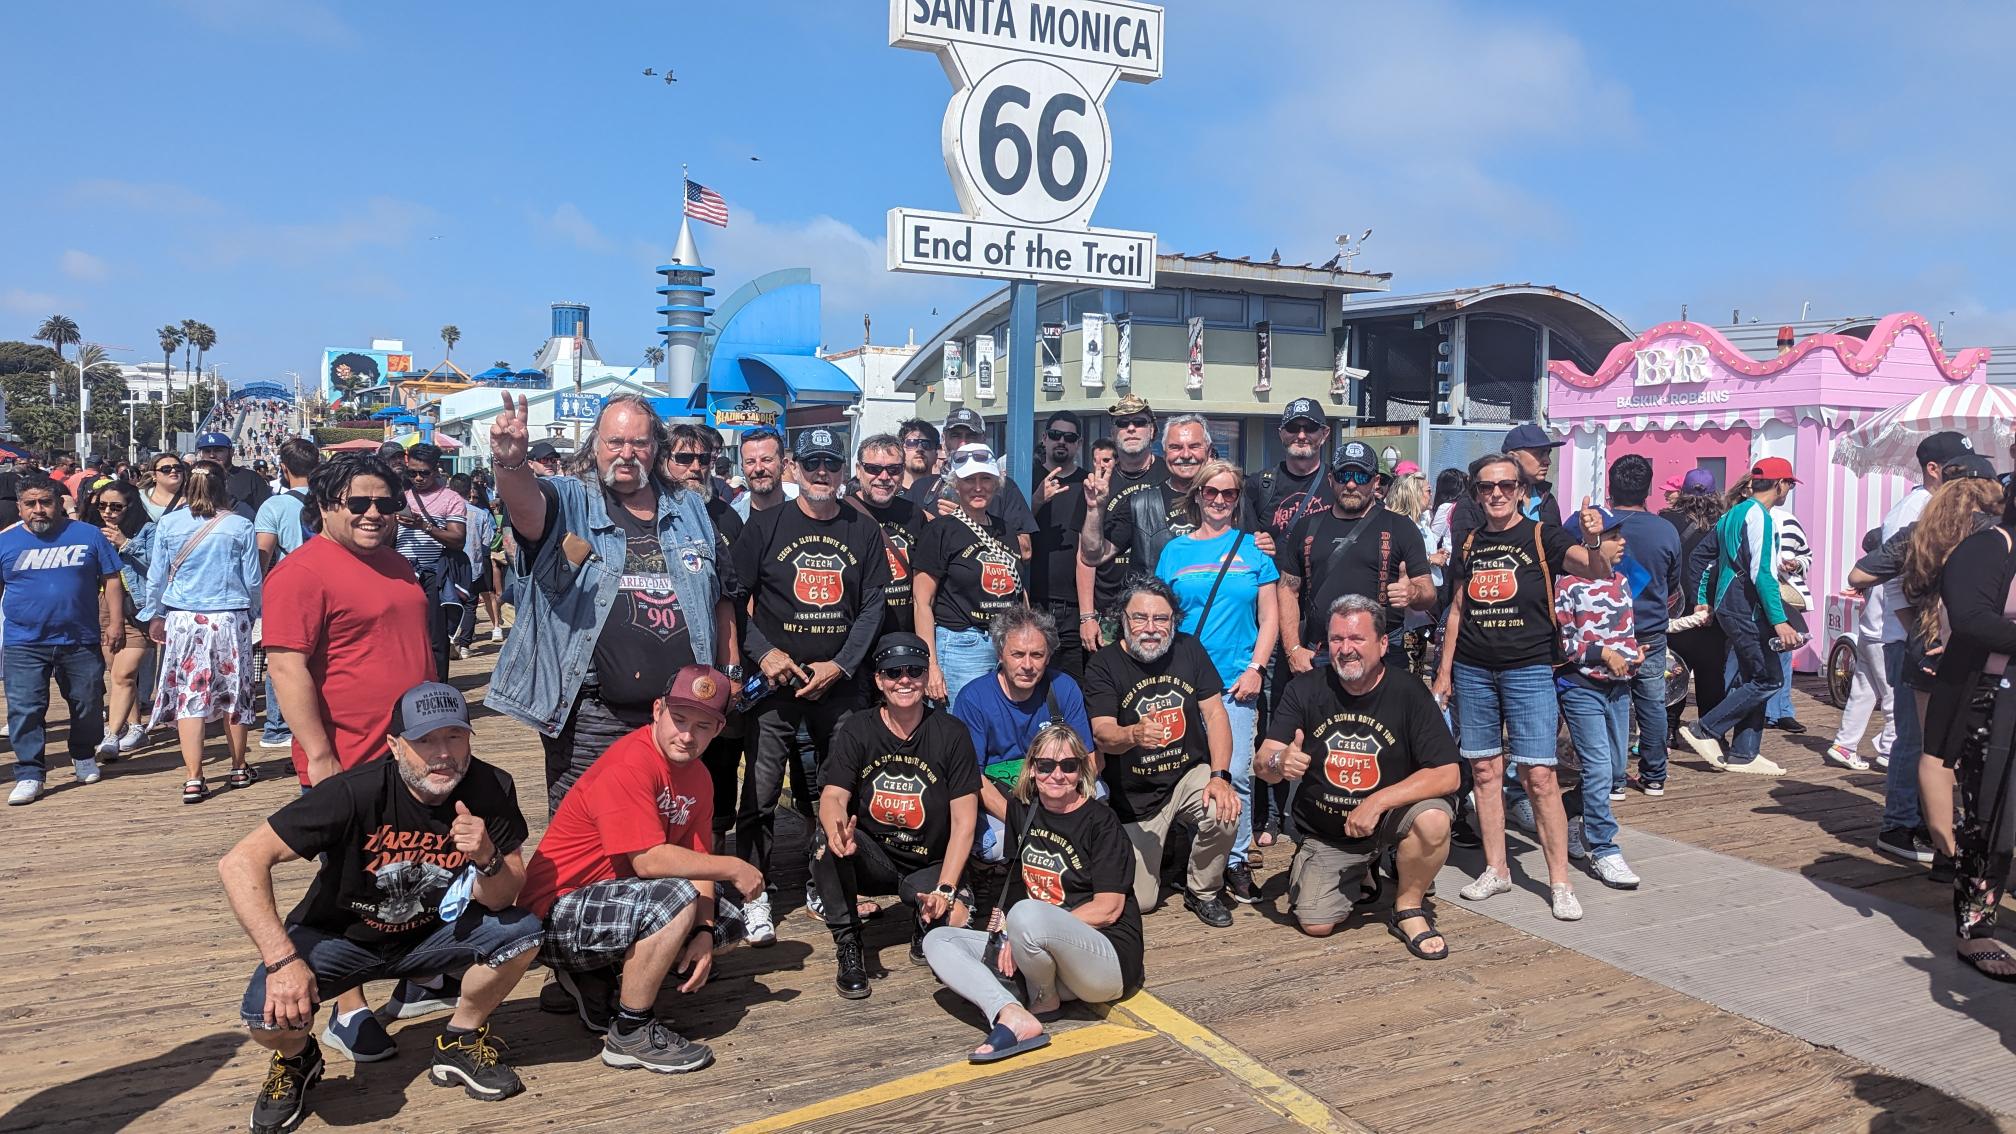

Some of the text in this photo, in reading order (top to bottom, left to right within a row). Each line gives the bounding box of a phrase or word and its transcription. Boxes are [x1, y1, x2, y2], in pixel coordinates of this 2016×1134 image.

[913, 0, 1152, 60] SANTA MONICA
[979, 85, 1088, 202] 66
[914, 225, 1143, 277] End of the Trail
[1634, 345, 1712, 386] BR
[1671, 390, 1729, 406] ROBBINS
[716, 410, 777, 427] BLAZING SADDLES
[777, 545, 793, 562] CZECH
[799, 535, 820, 544] SLOVAK
[822, 535, 840, 548] ROUTE
[20, 544, 89, 571] NIKE
[805, 558, 833, 568] CZECH
[1482, 560, 1505, 569] ZECH
[1519, 552, 1533, 566] TOUR
[620, 577, 670, 589] ARLEY-DAV
[800, 572, 836, 586] ROUTE
[991, 578, 1007, 590] 66
[1474, 573, 1509, 585] ROUTE
[808, 586, 829, 600] 66
[1478, 585, 1500, 598] 66
[887, 598, 900, 606] MAY
[647, 607, 676, 629] 90
[795, 611, 842, 620] ASSOCIATION
[971, 611, 984, 620] MAY
[1829, 613, 1841, 629] BR
[783, 622, 796, 633] MAY
[798, 625, 803, 633] 2
[811, 625, 825, 634] MAY
[826, 625, 835, 633] 22
[1483, 620, 1496, 628] MAY
[1508, 619, 1524, 627] 2024
[1136, 676, 1156, 690] SLOVAK
[422, 691, 450, 699] HARLEY
[415, 696, 459, 713] FUCKING
[1163, 726, 1173, 740] 6
[1333, 713, 1356, 722] SLOVAK
[1382, 729, 1396, 746] TOUR
[1337, 740, 1368, 752] CZECH
[1142, 748, 1182, 764] ASSOCIATIO
[1330, 753, 1371, 769] ROUTE
[1132, 766, 1146, 775] MAY
[1147, 767, 1152, 775] 2
[1158, 763, 1171, 773] MAY
[1172, 761, 1181, 770] 22
[1339, 769, 1362, 785] 66
[883, 780, 914, 792] CZECH
[875, 794, 916, 812] ROUTE
[1324, 793, 1361, 805] ASSOCIAT
[1328, 806, 1333, 814] 2
[362, 824, 450, 853] HARLEY
[1049, 832, 1068, 848] ROUTE
[1027, 852, 1055, 869] CZECH
[1024, 868, 1055, 888] ROUTE
[350, 901, 376, 912] 1966
[361, 914, 435, 933] SHOVELHEAD
